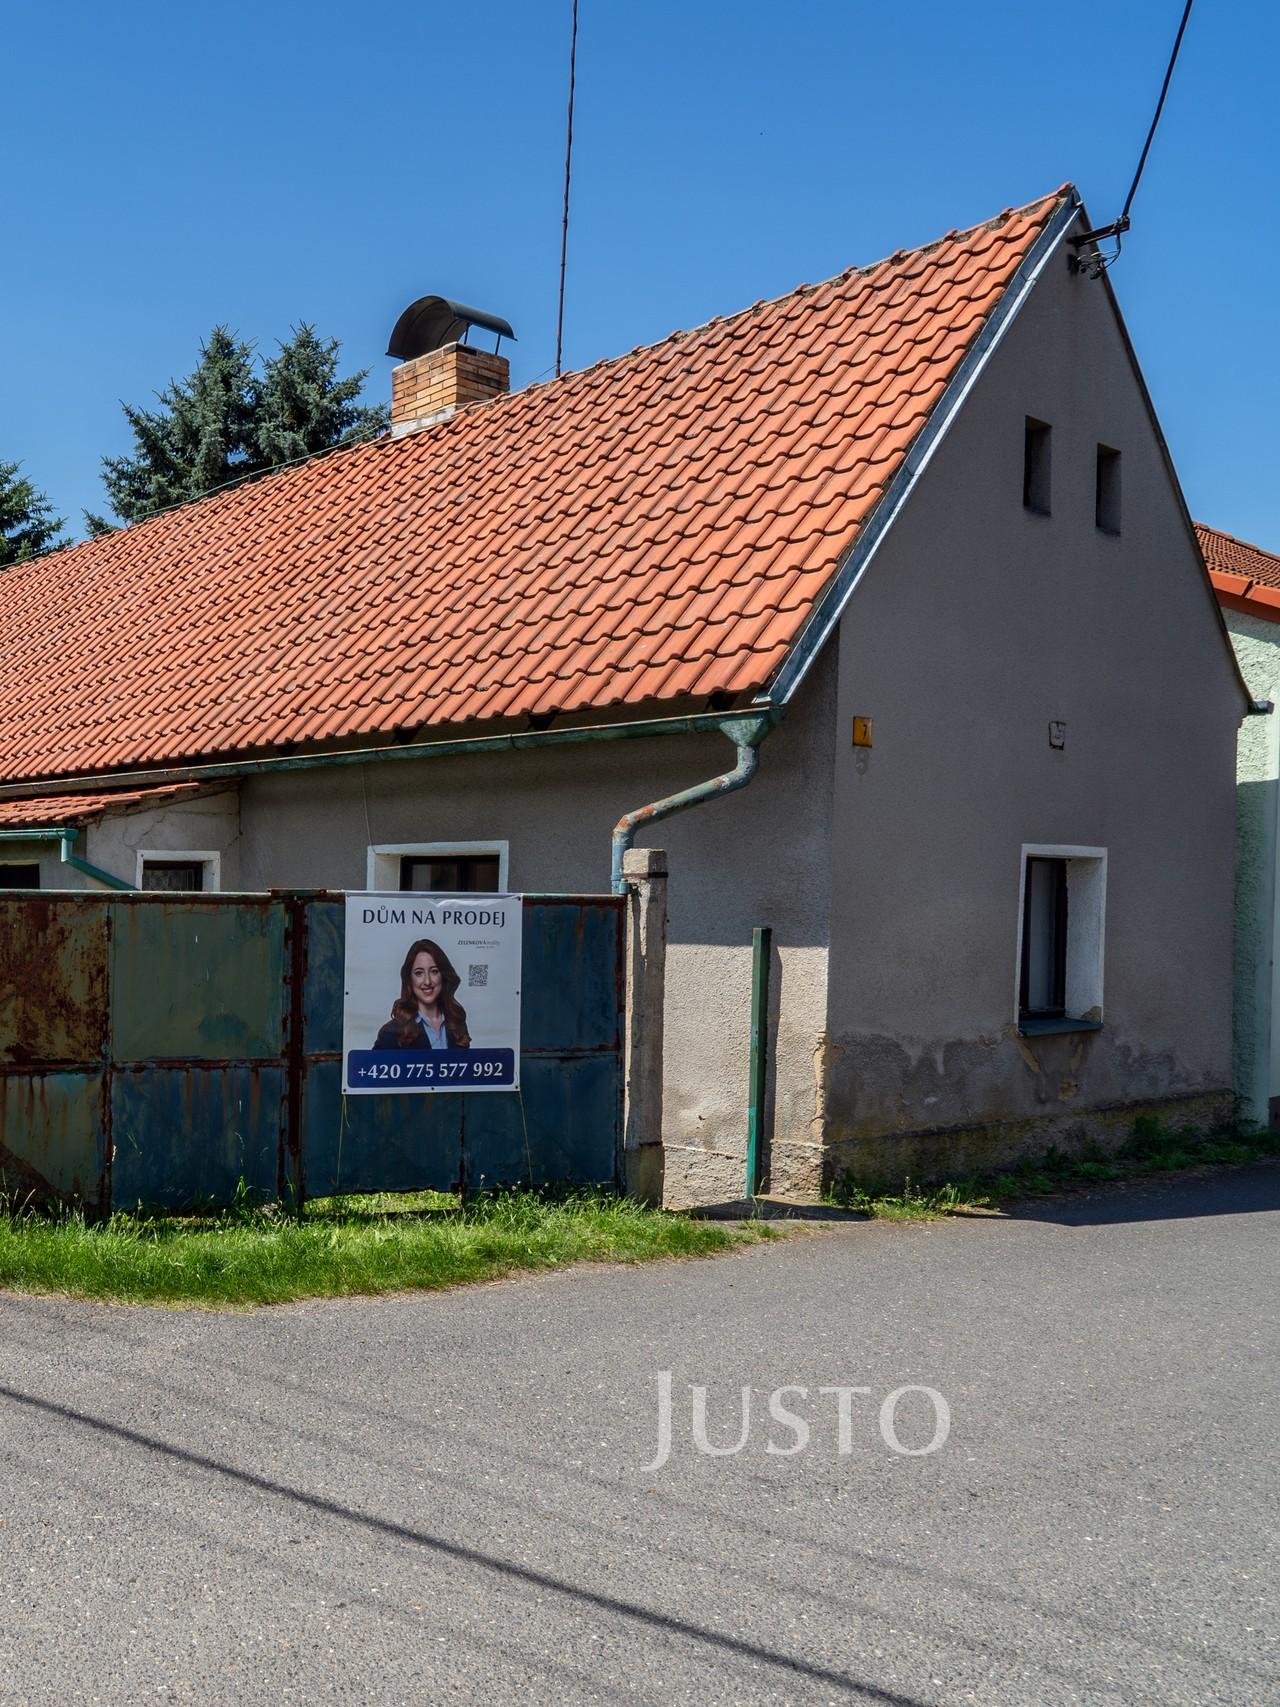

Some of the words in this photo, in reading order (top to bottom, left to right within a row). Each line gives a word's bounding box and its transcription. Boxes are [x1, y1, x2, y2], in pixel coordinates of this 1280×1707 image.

[362, 905, 406, 924] DŮM
[412, 910, 436, 925] NA
[442, 910, 505, 928] PRODEJ
[358, 1064, 401, 1079] +420
[406, 1063, 434, 1078] 775
[439, 1062, 468, 1078] 577
[473, 1062, 503, 1077] 992
